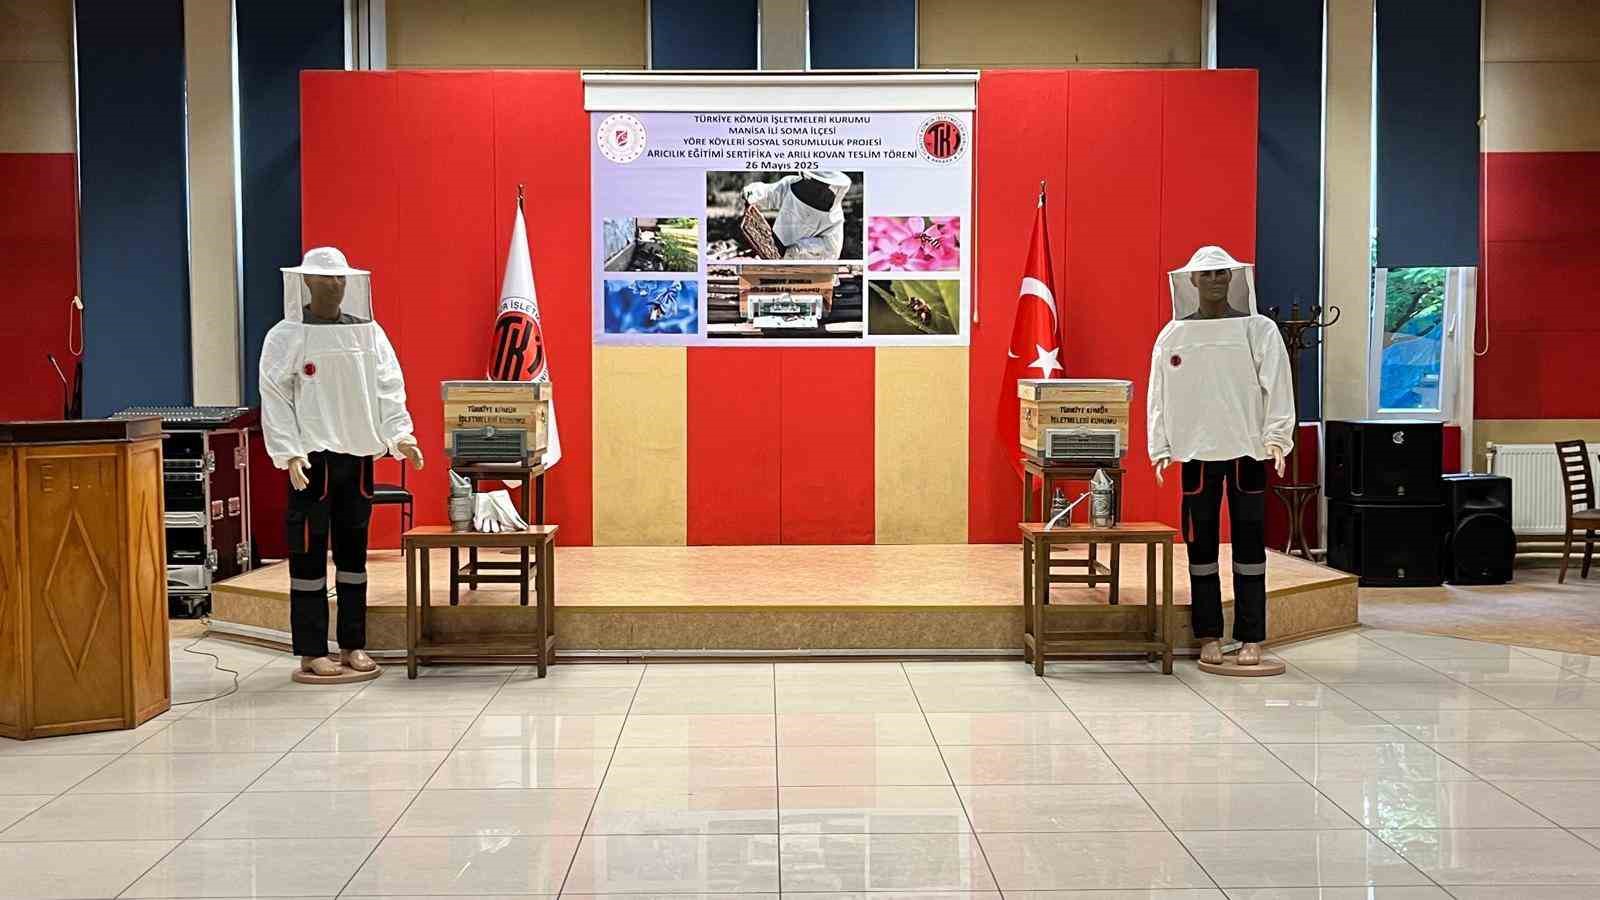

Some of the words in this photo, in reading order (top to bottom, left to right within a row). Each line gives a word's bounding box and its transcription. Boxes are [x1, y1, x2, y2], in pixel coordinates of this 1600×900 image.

[694, 114, 732, 124] TÜRKİYE
[734, 114, 768, 124] KÖMÜR
[771, 114, 828, 125] İŞLETMELERİ
[830, 116, 871, 124] KURUMU
[728, 127, 765, 135] MANİSA
[768, 127, 778, 135] İLİ
[780, 127, 809, 135] SOMA
[810, 127, 837, 136] İLÇESİ
[683, 137, 706, 146] YÖRE
[708, 137, 745, 146] KÖYLERİ
[747, 138, 781, 146] SOSYAL
[782, 138, 845, 146] SORUMLULUK
[847, 138, 882, 146] PROJESİ
[647, 149, 686, 158] ARICILIK
[688, 148, 724, 158] EĞİTİMİ
[726, 149, 772, 159] SERTİFİKA
[787, 150, 811, 159] ARILI
[813, 150, 846, 159] KOVAN
[848, 150, 881, 159] TESLİM
[884, 149, 918, 159] TÖRENİ
[745, 161, 758, 170] 26
[761, 161, 791, 171] Mayıs
[794, 161, 819, 170] 2025
